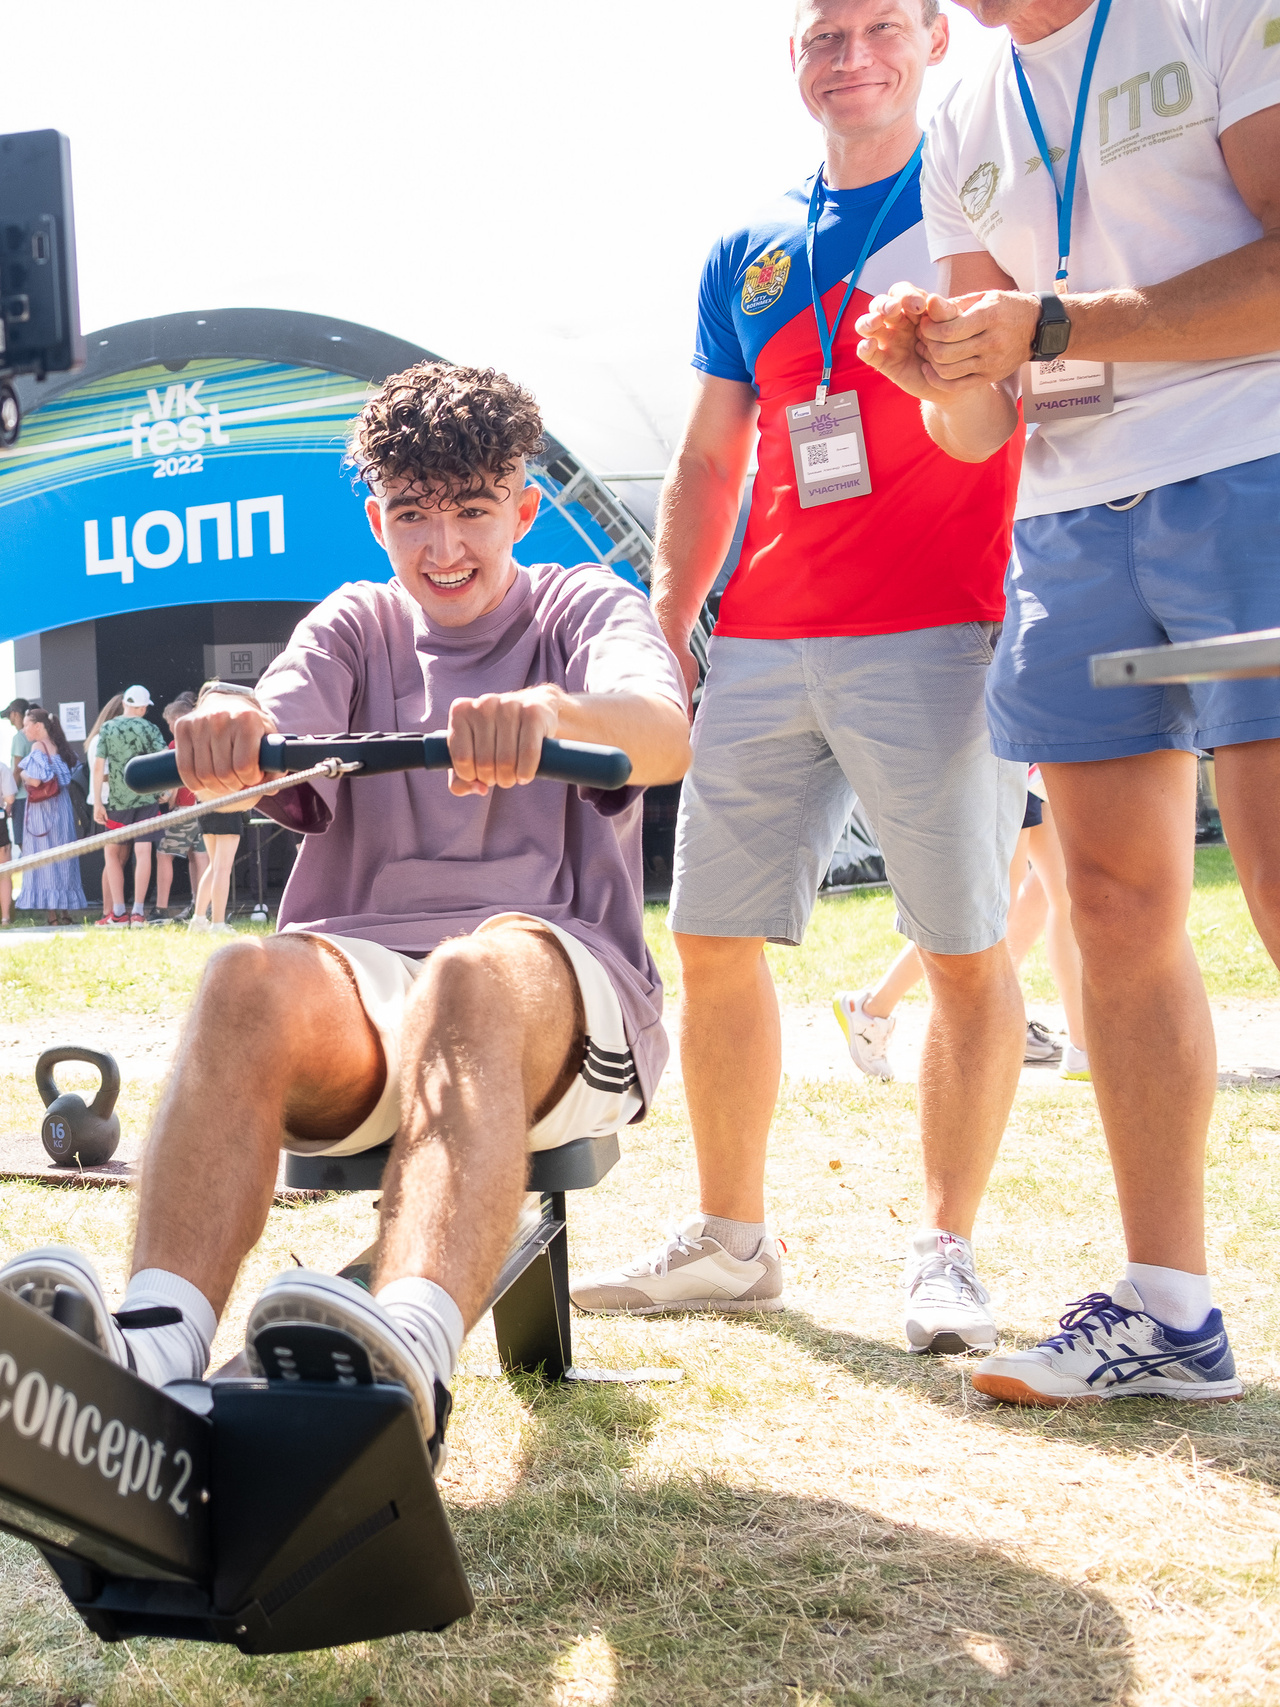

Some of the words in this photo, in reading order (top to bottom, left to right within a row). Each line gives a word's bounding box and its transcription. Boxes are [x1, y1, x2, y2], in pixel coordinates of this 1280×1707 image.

[1098, 61, 1193, 146] ГТО
[147, 379, 206, 421] VK
[1035, 394, 1101, 411] УЧАСТНИК
[811, 417, 840, 432] fest
[815, 413, 832, 423] VK
[131, 403, 230, 459] fest
[153, 453, 204, 479] 2022
[808, 479, 860, 496] УЧАСТНИК
[84, 494, 285, 584] ЦОПП
[49, 1122, 65, 1139] 16
[53, 1140, 63, 1148] KG
